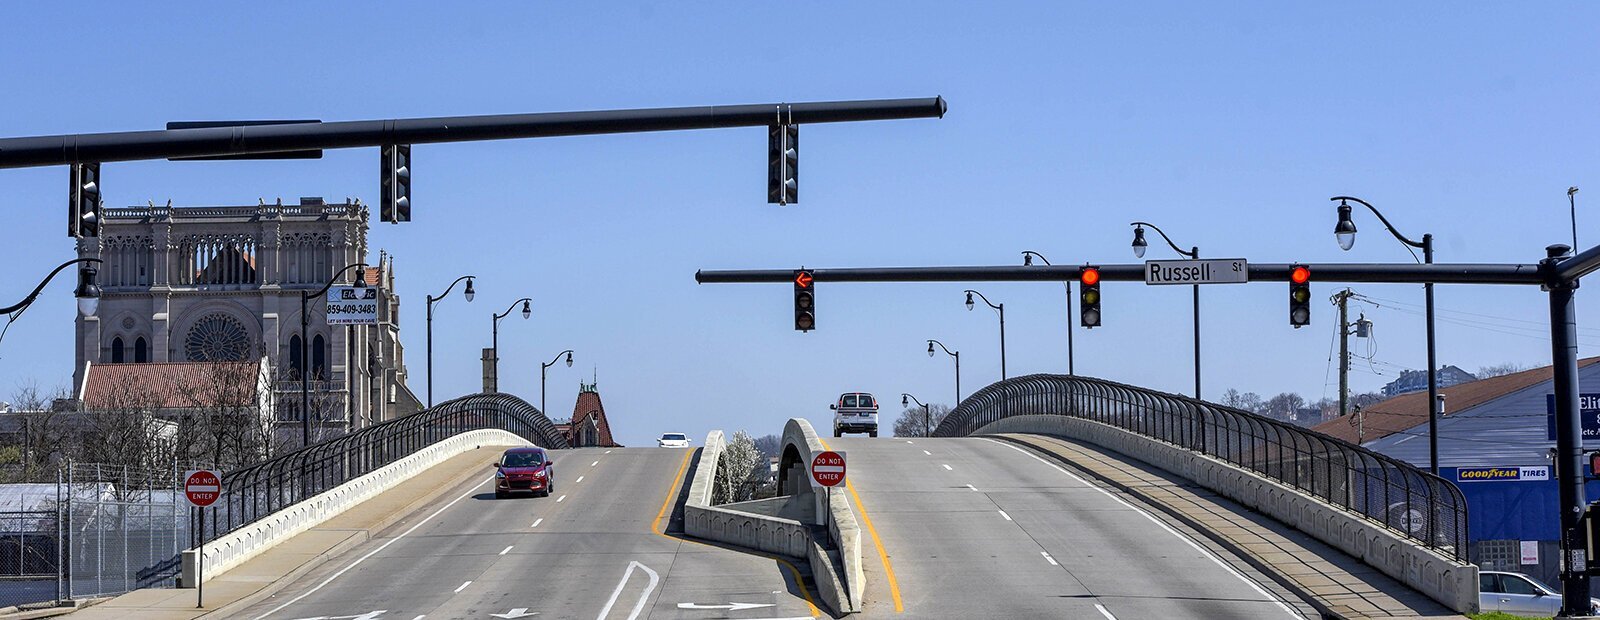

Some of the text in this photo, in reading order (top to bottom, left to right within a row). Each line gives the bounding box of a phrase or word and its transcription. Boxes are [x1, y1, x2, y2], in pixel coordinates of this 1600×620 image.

[1151, 262, 1242, 281] Russell St
[327, 304, 376, 314] 859-409-3483
[1462, 468, 1518, 478] GOODYEAR
